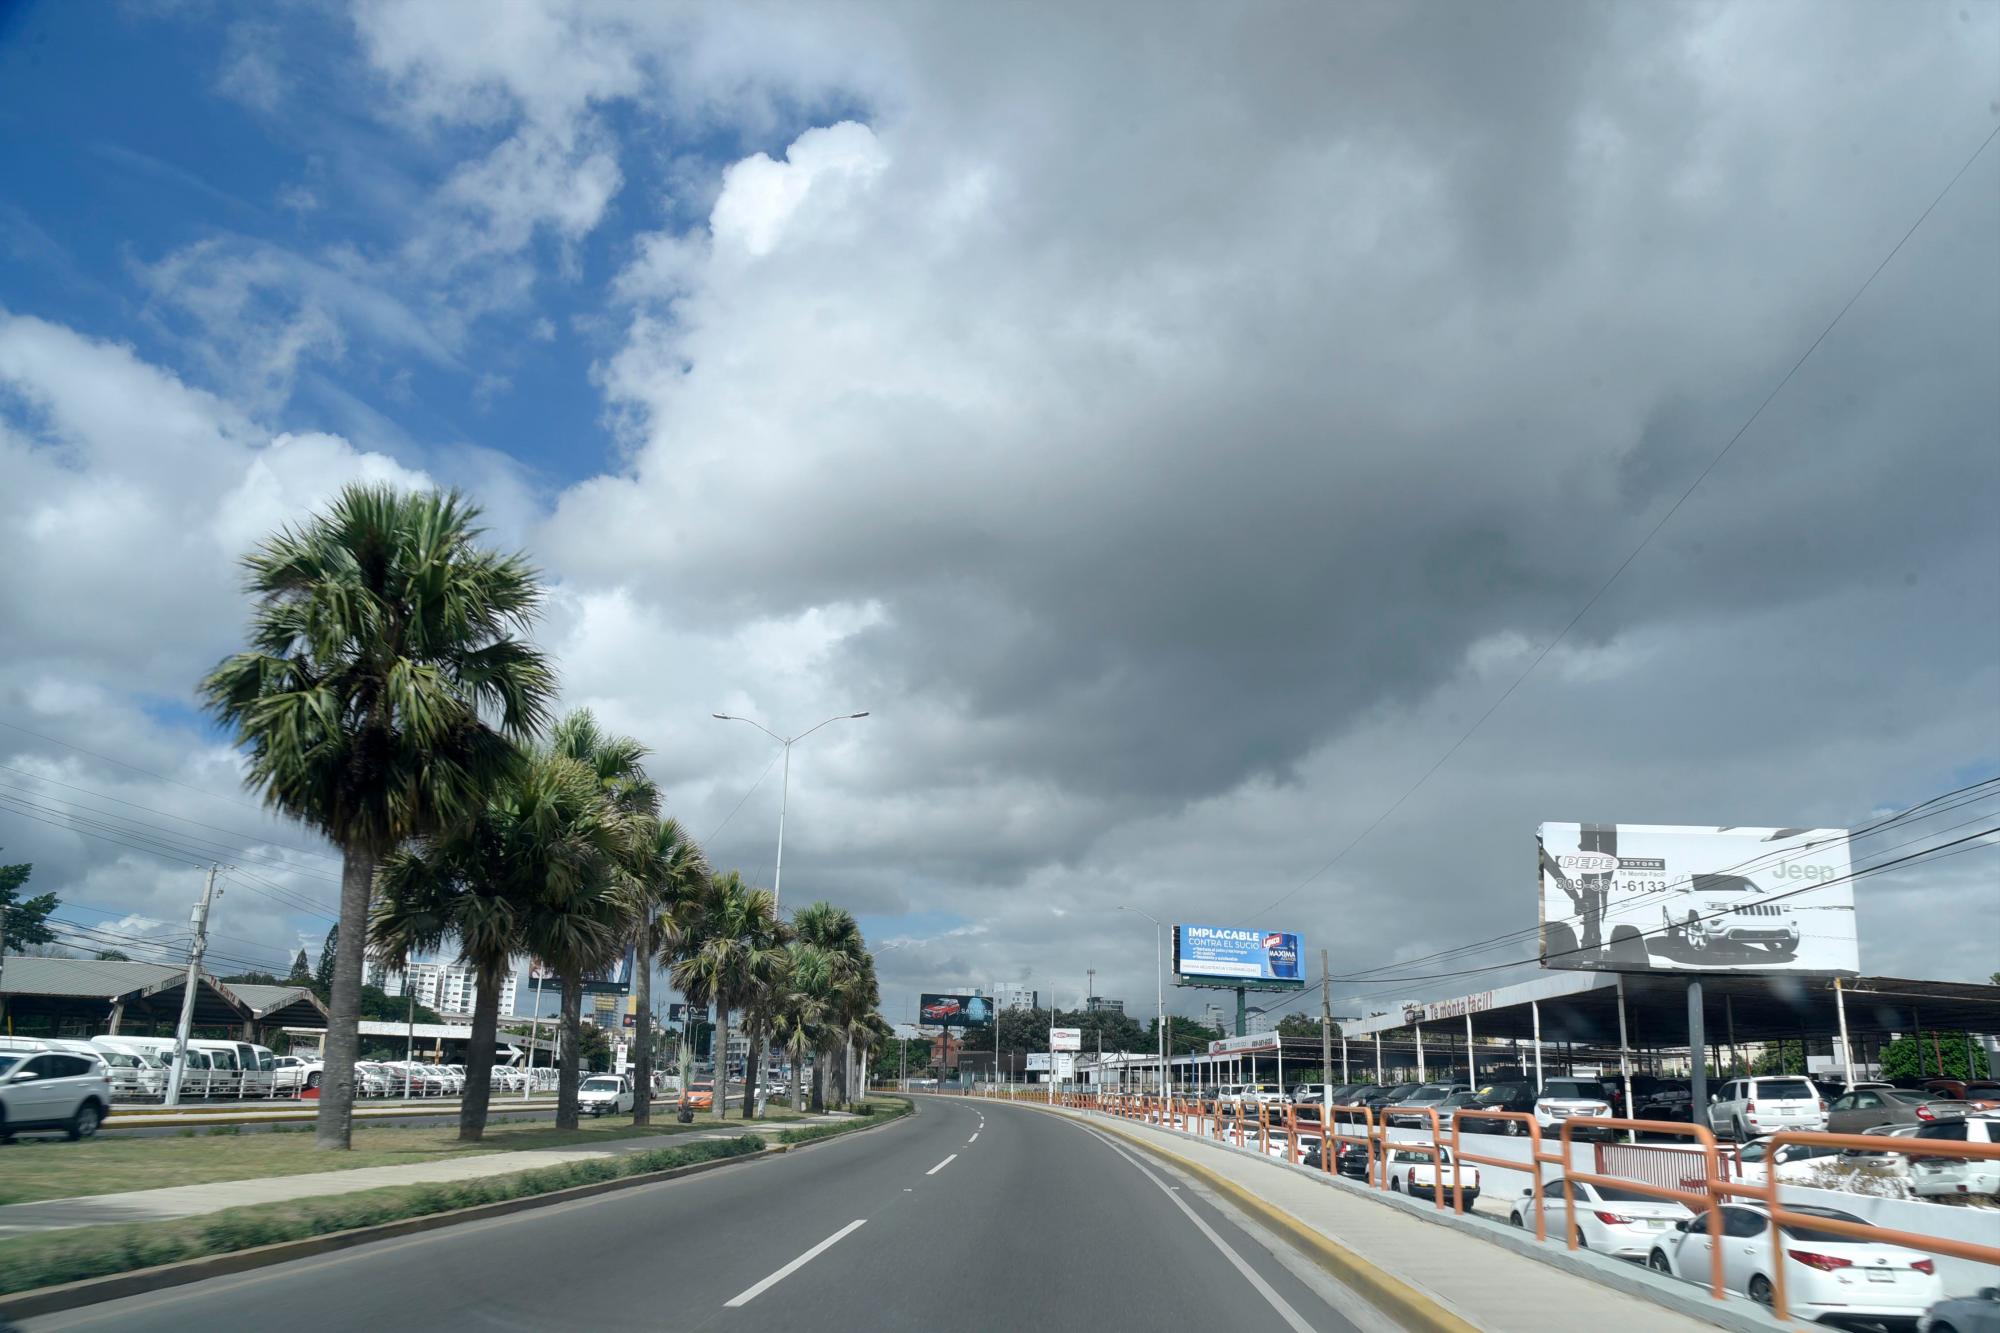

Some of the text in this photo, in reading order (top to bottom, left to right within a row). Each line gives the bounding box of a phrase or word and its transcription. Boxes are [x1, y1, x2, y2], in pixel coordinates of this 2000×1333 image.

[1563, 856, 1614, 869] PEPE
[1772, 859, 1834, 883] Jeep
[1556, 878, 1667, 892] 809-581-6133
[1188, 927, 1260, 942] IMPLACABLE
[1188, 937, 1260, 950] CONTRA EL SUCIO
[1429, 1004, 1438, 1020] Te
[1440, 999, 1466, 1017] monta
